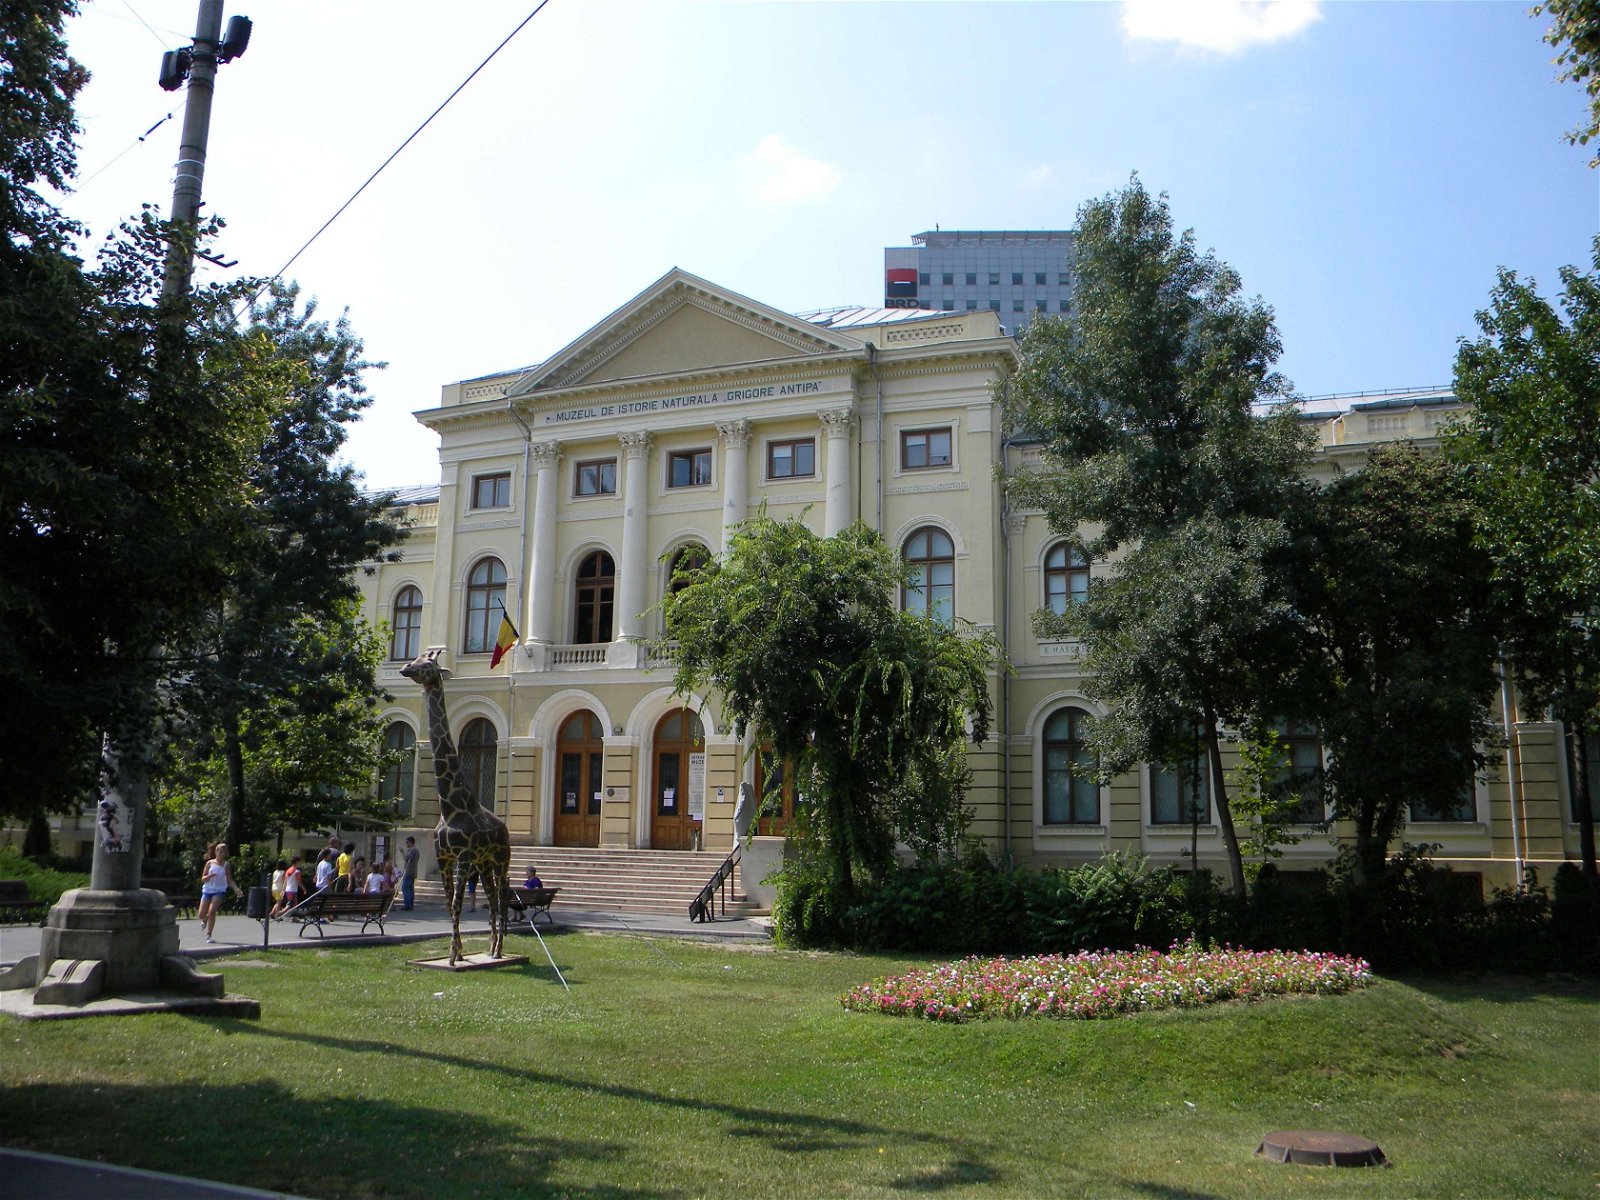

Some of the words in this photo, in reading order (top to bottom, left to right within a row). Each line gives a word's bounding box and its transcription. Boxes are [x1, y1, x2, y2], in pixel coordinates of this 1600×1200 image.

[885, 298, 920, 309] BRD
[556, 408, 597, 421] MUZEUL
[601, 406, 614, 416] DE
[618, 400, 658, 414] ISTORIE
[662, 393, 718, 409] NATURALA
[1053, 645, 1089, 653] HAECE
